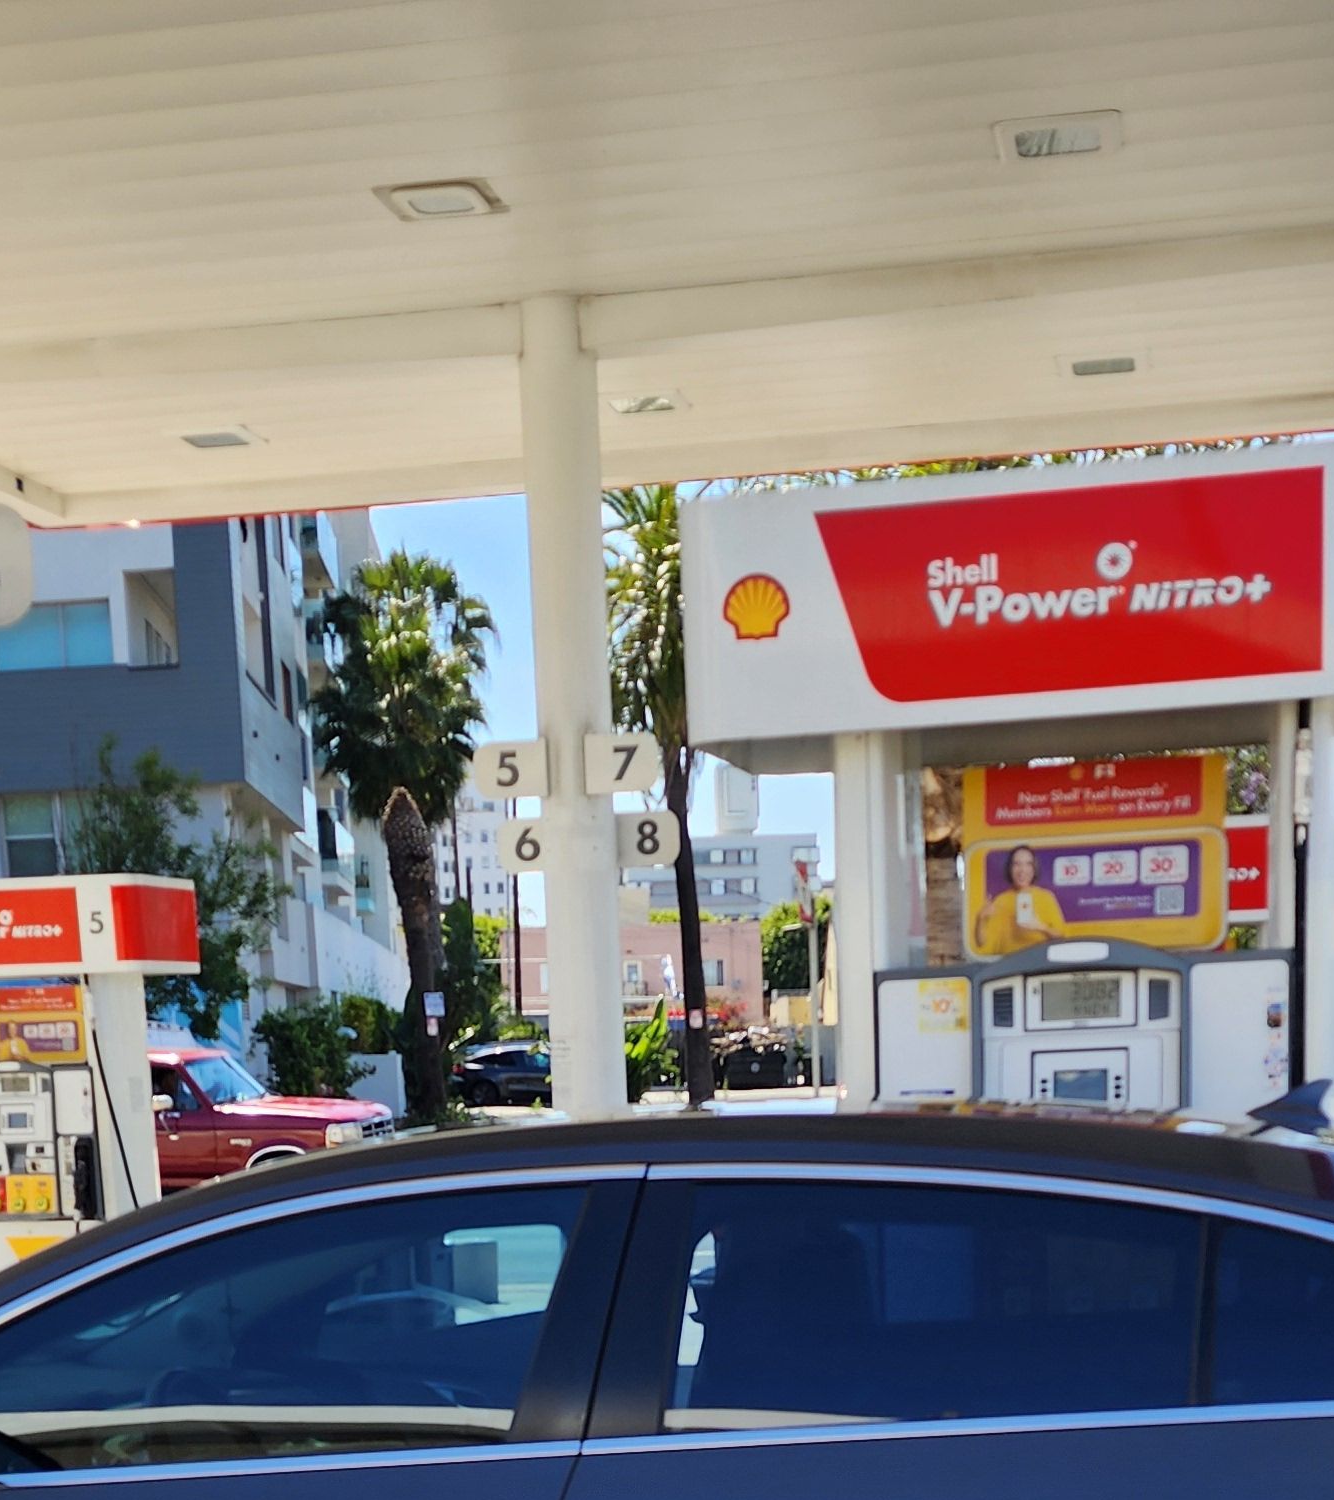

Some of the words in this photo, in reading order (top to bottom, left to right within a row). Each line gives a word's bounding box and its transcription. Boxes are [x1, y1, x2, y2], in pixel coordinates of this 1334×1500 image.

[926, 552, 998, 589] Shell
[927, 585, 1114, 628] V-Power
[496, 751, 520, 788] 5
[612, 745, 639, 782] 7
[1050, 787, 1080, 804] Shell
[1083, 785, 1109, 801] Fuel
[1111, 782, 1164, 800] Rewards
[995, 806, 1052, 820] Members
[515, 826, 541, 862] 6
[636, 820, 660, 855] 8
[89, 911, 104, 934] 5
